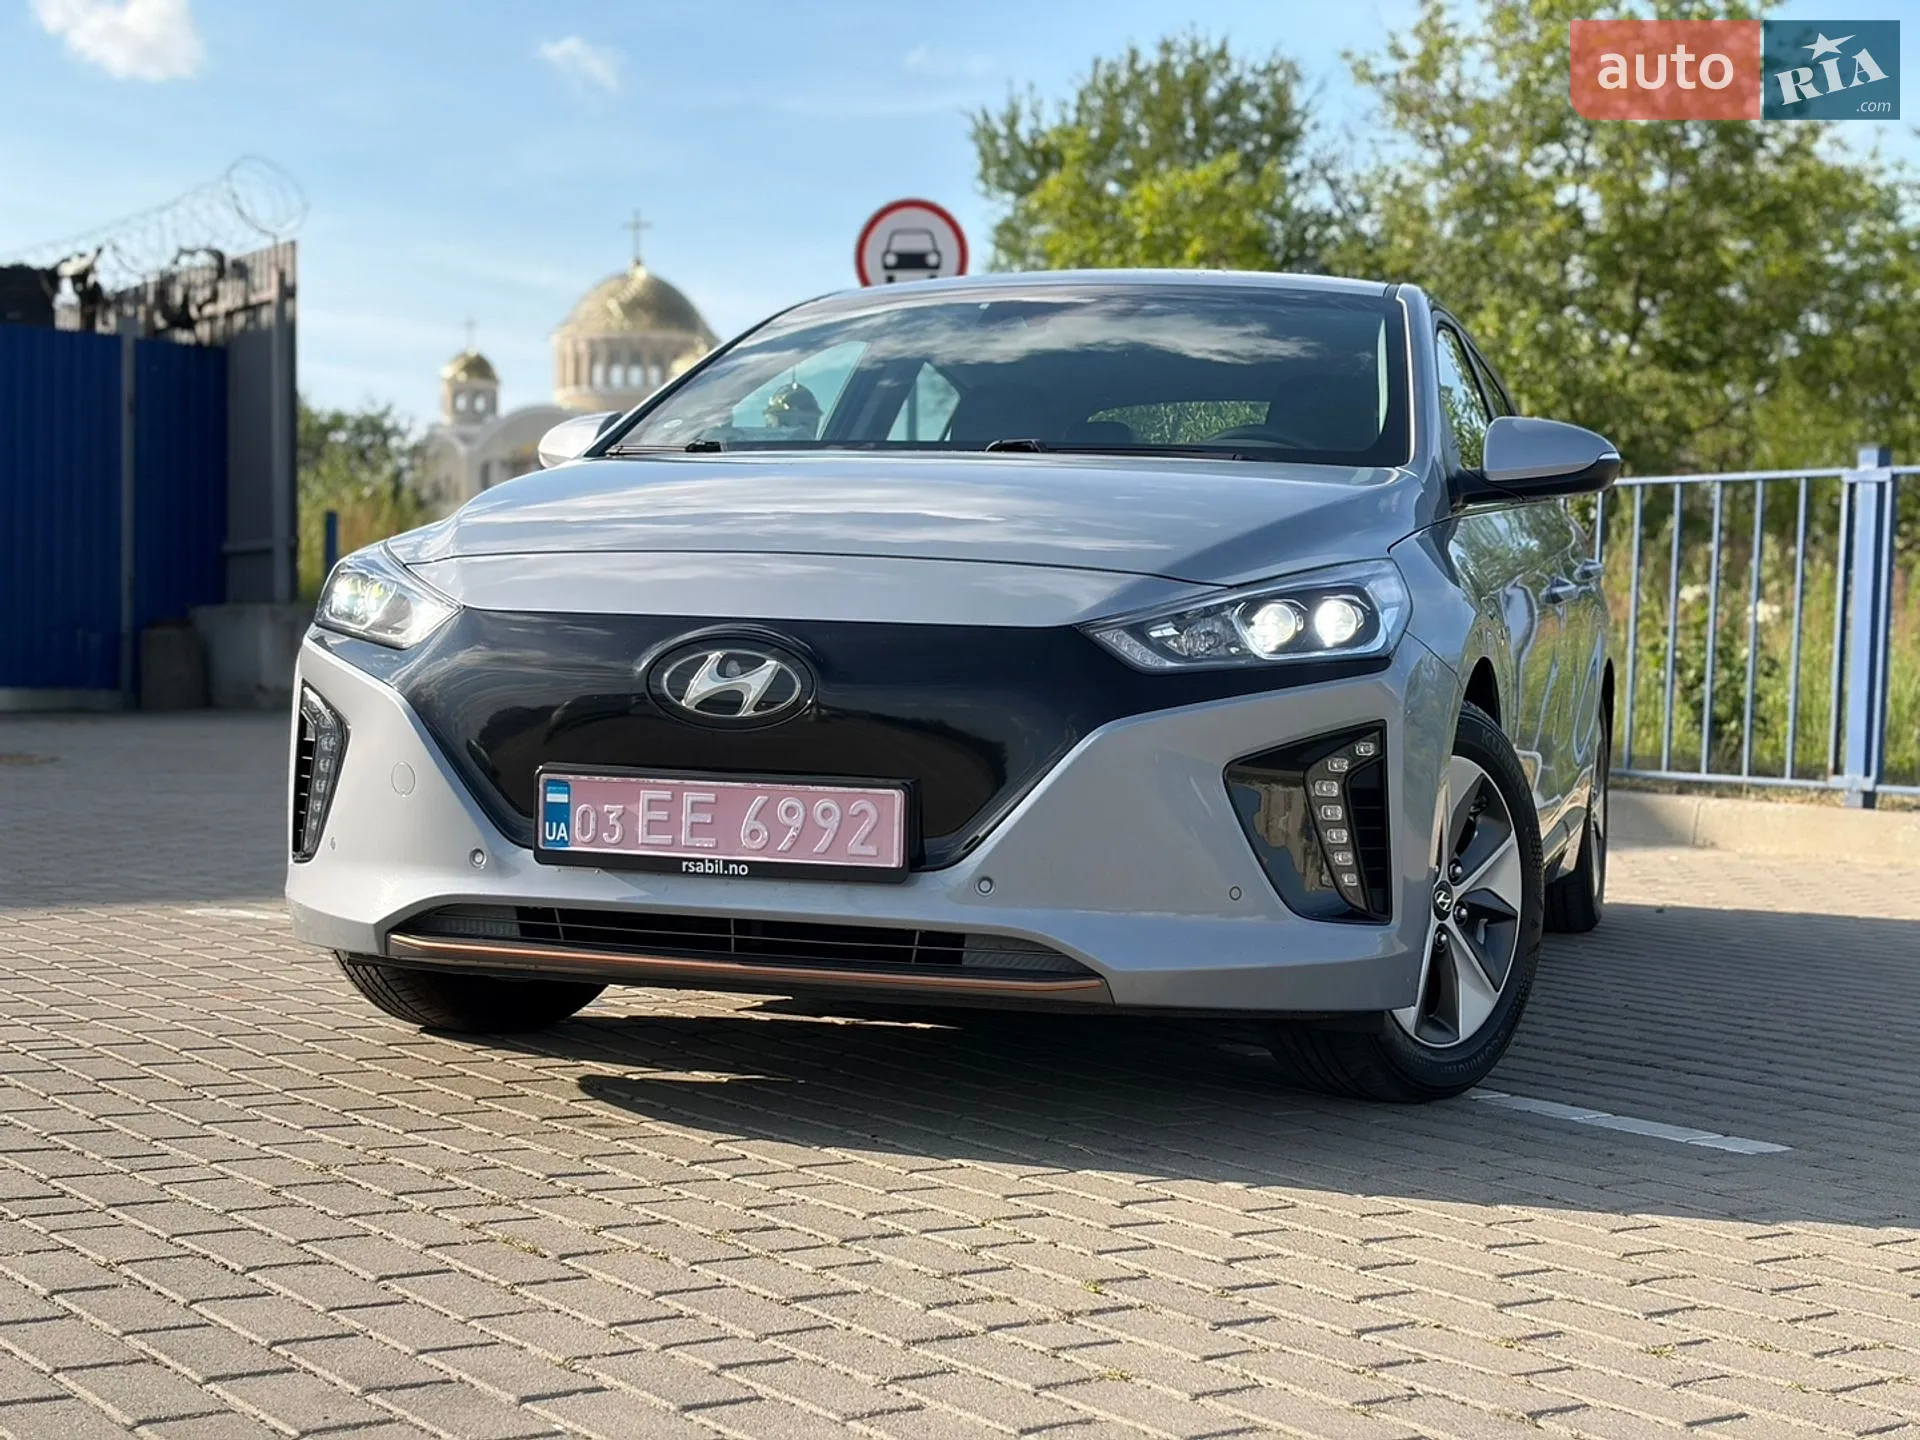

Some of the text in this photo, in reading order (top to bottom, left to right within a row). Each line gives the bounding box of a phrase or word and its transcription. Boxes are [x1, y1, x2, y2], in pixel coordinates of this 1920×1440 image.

[545, 790, 879, 857] UA 03 EE 6992
[682, 859, 749, 876] rsabil.no
